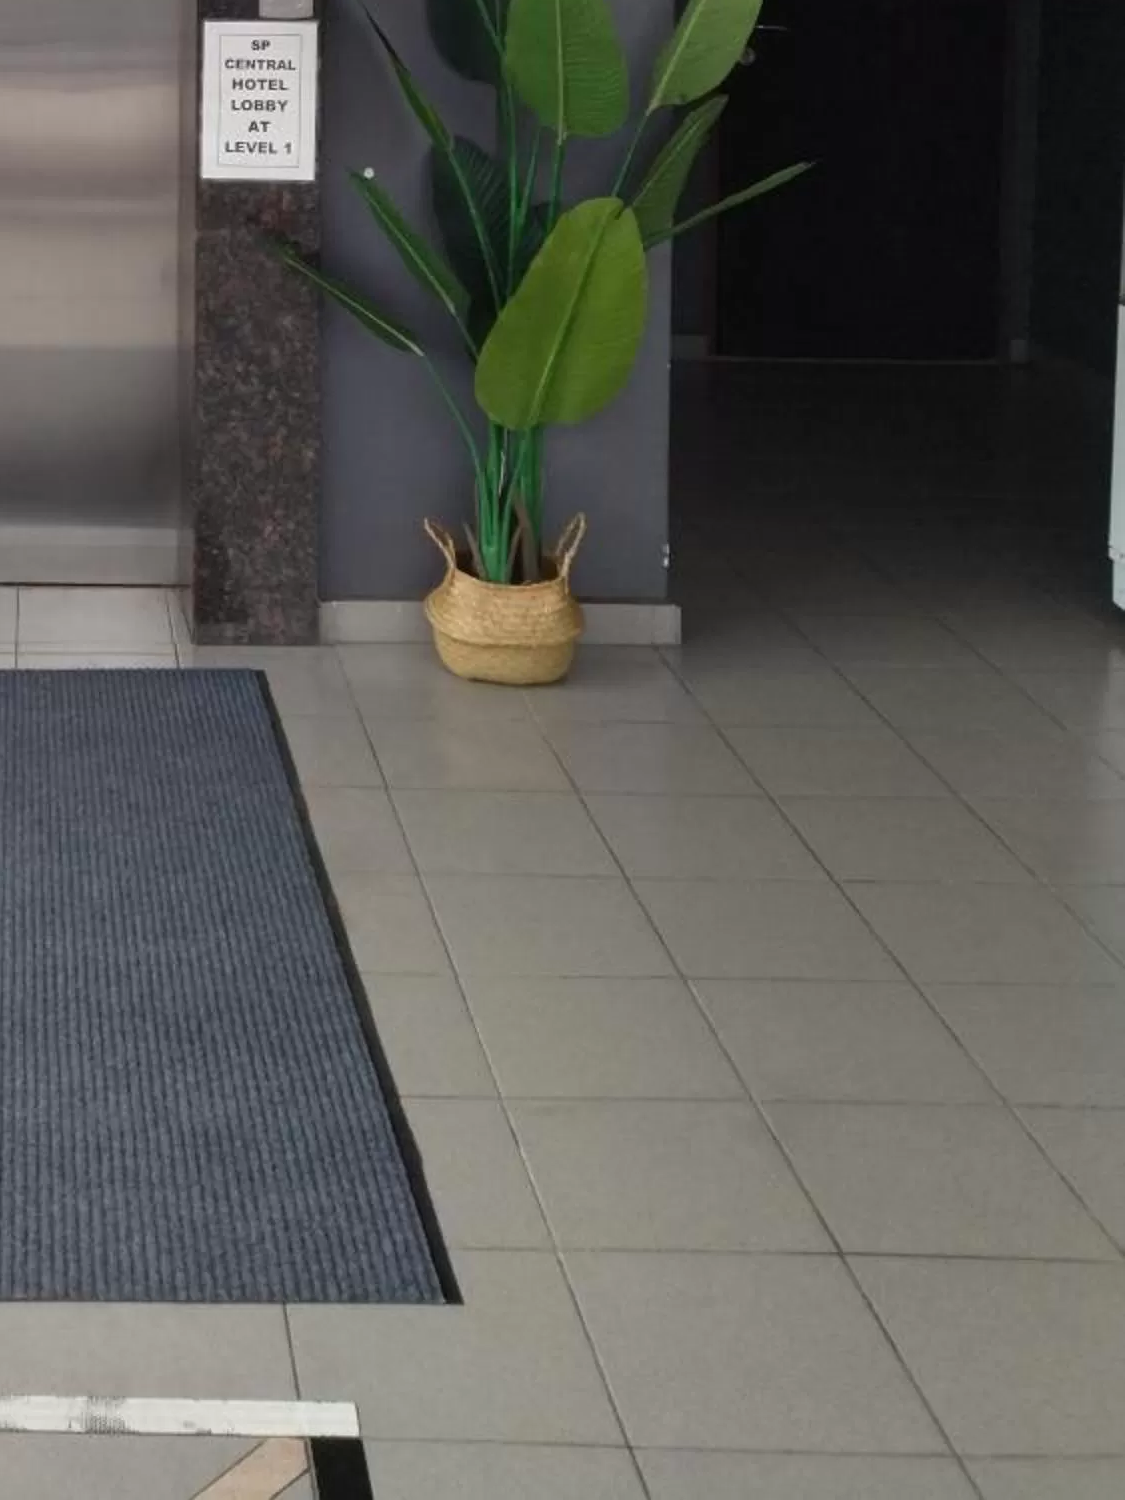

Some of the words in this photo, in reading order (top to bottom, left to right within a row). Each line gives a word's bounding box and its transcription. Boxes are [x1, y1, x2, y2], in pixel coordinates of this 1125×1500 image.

[251, 39, 271, 51] SP
[225, 59, 296, 71] CENTRAL
[232, 78, 289, 91] HOTEL
[231, 99, 289, 112] LOBBY
[248, 120, 272, 133] AT
[225, 141, 278, 154] LEVEL
[284, 141, 293, 154] 1
